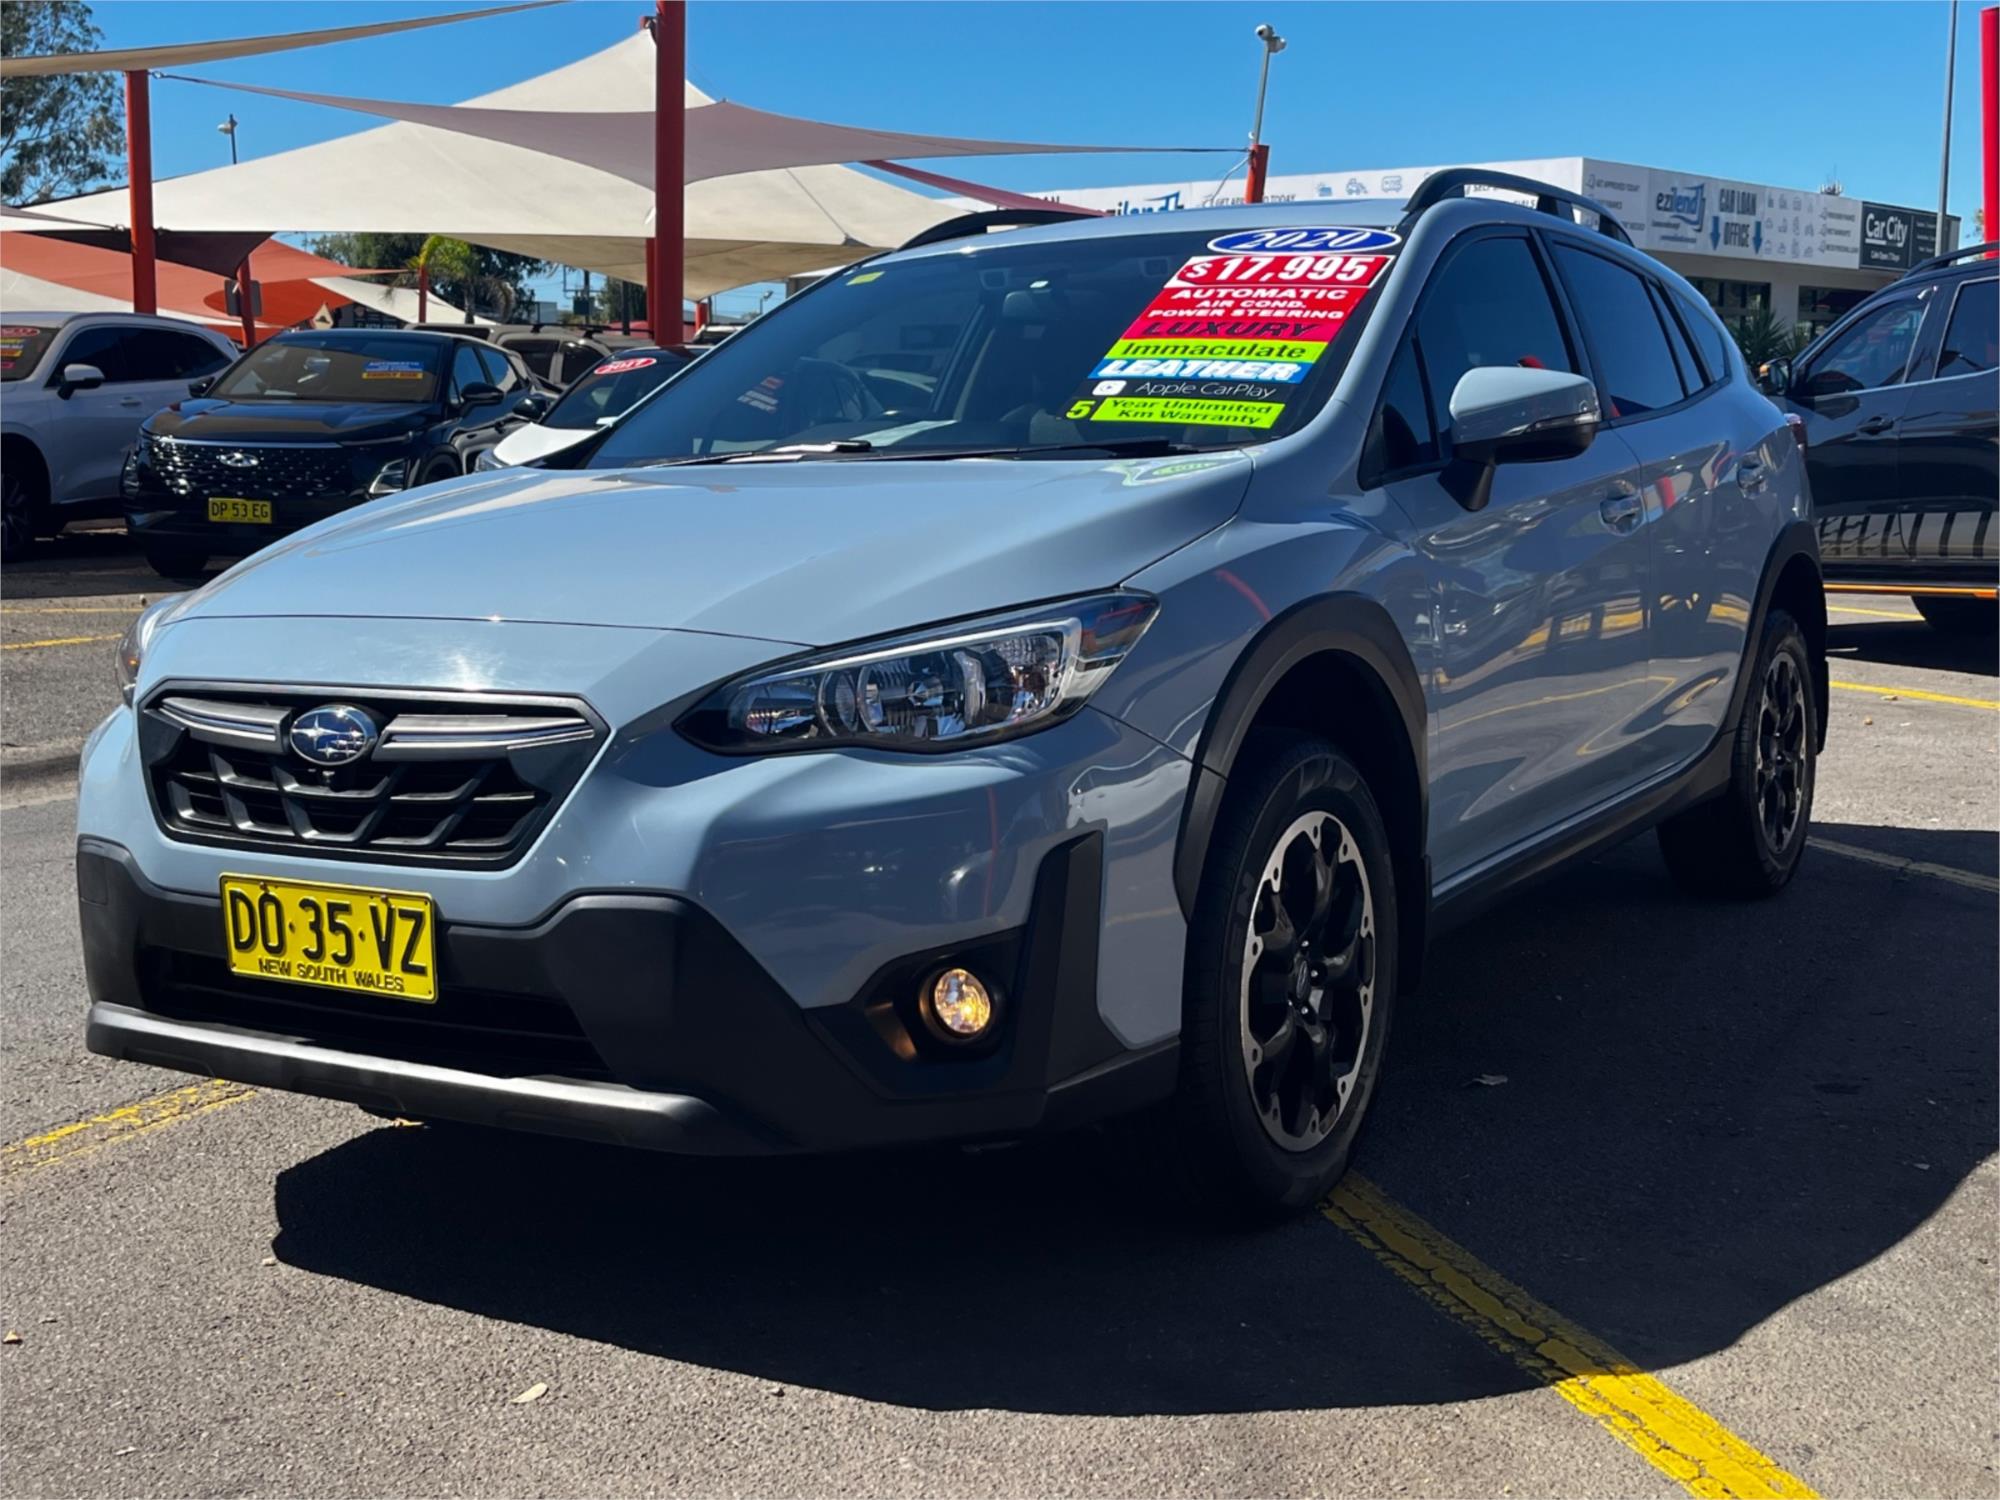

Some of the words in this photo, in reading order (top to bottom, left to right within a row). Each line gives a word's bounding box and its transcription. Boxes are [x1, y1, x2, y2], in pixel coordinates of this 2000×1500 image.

[1720, 188, 1735, 213] CAR
[1736, 190, 1757, 216] LOAN
[1723, 221, 1750, 248] OFFICE
[1865, 213, 1886, 238] Car
[1886, 216, 1908, 248] City
[1230, 231, 1373, 249] 2020
[1185, 256, 1376, 282] $17,995
[1170, 288, 1349, 300] AUTOMATIC
[1195, 300, 1236, 308] AIR
[1239, 300, 1307, 309] COND.
[1147, 308, 1225, 318] POWER
[1230, 308, 1344, 319] STEERING
[1143, 321, 1322, 336] LUXURY
[1121, 342, 1306, 359] Immaculate
[1098, 359, 1301, 381] LEATHER
[1135, 382, 1196, 395] Apple
[1200, 383, 1276, 399] CarPlay
[1065, 401, 1095, 419] 5
[1112, 399, 1160, 409] Year
[1163, 401, 1272, 414] Unlimited
[1117, 409, 1153, 418] Km
[1158, 411, 1261, 425] Warranty
[211, 502, 227, 517] DP
[232, 503, 248, 517] 53
[252, 503, 268, 518] EG
[258, 958, 291, 976] NEW
[297, 963, 347, 984] SOUTH
[353, 970, 404, 993] WALES
